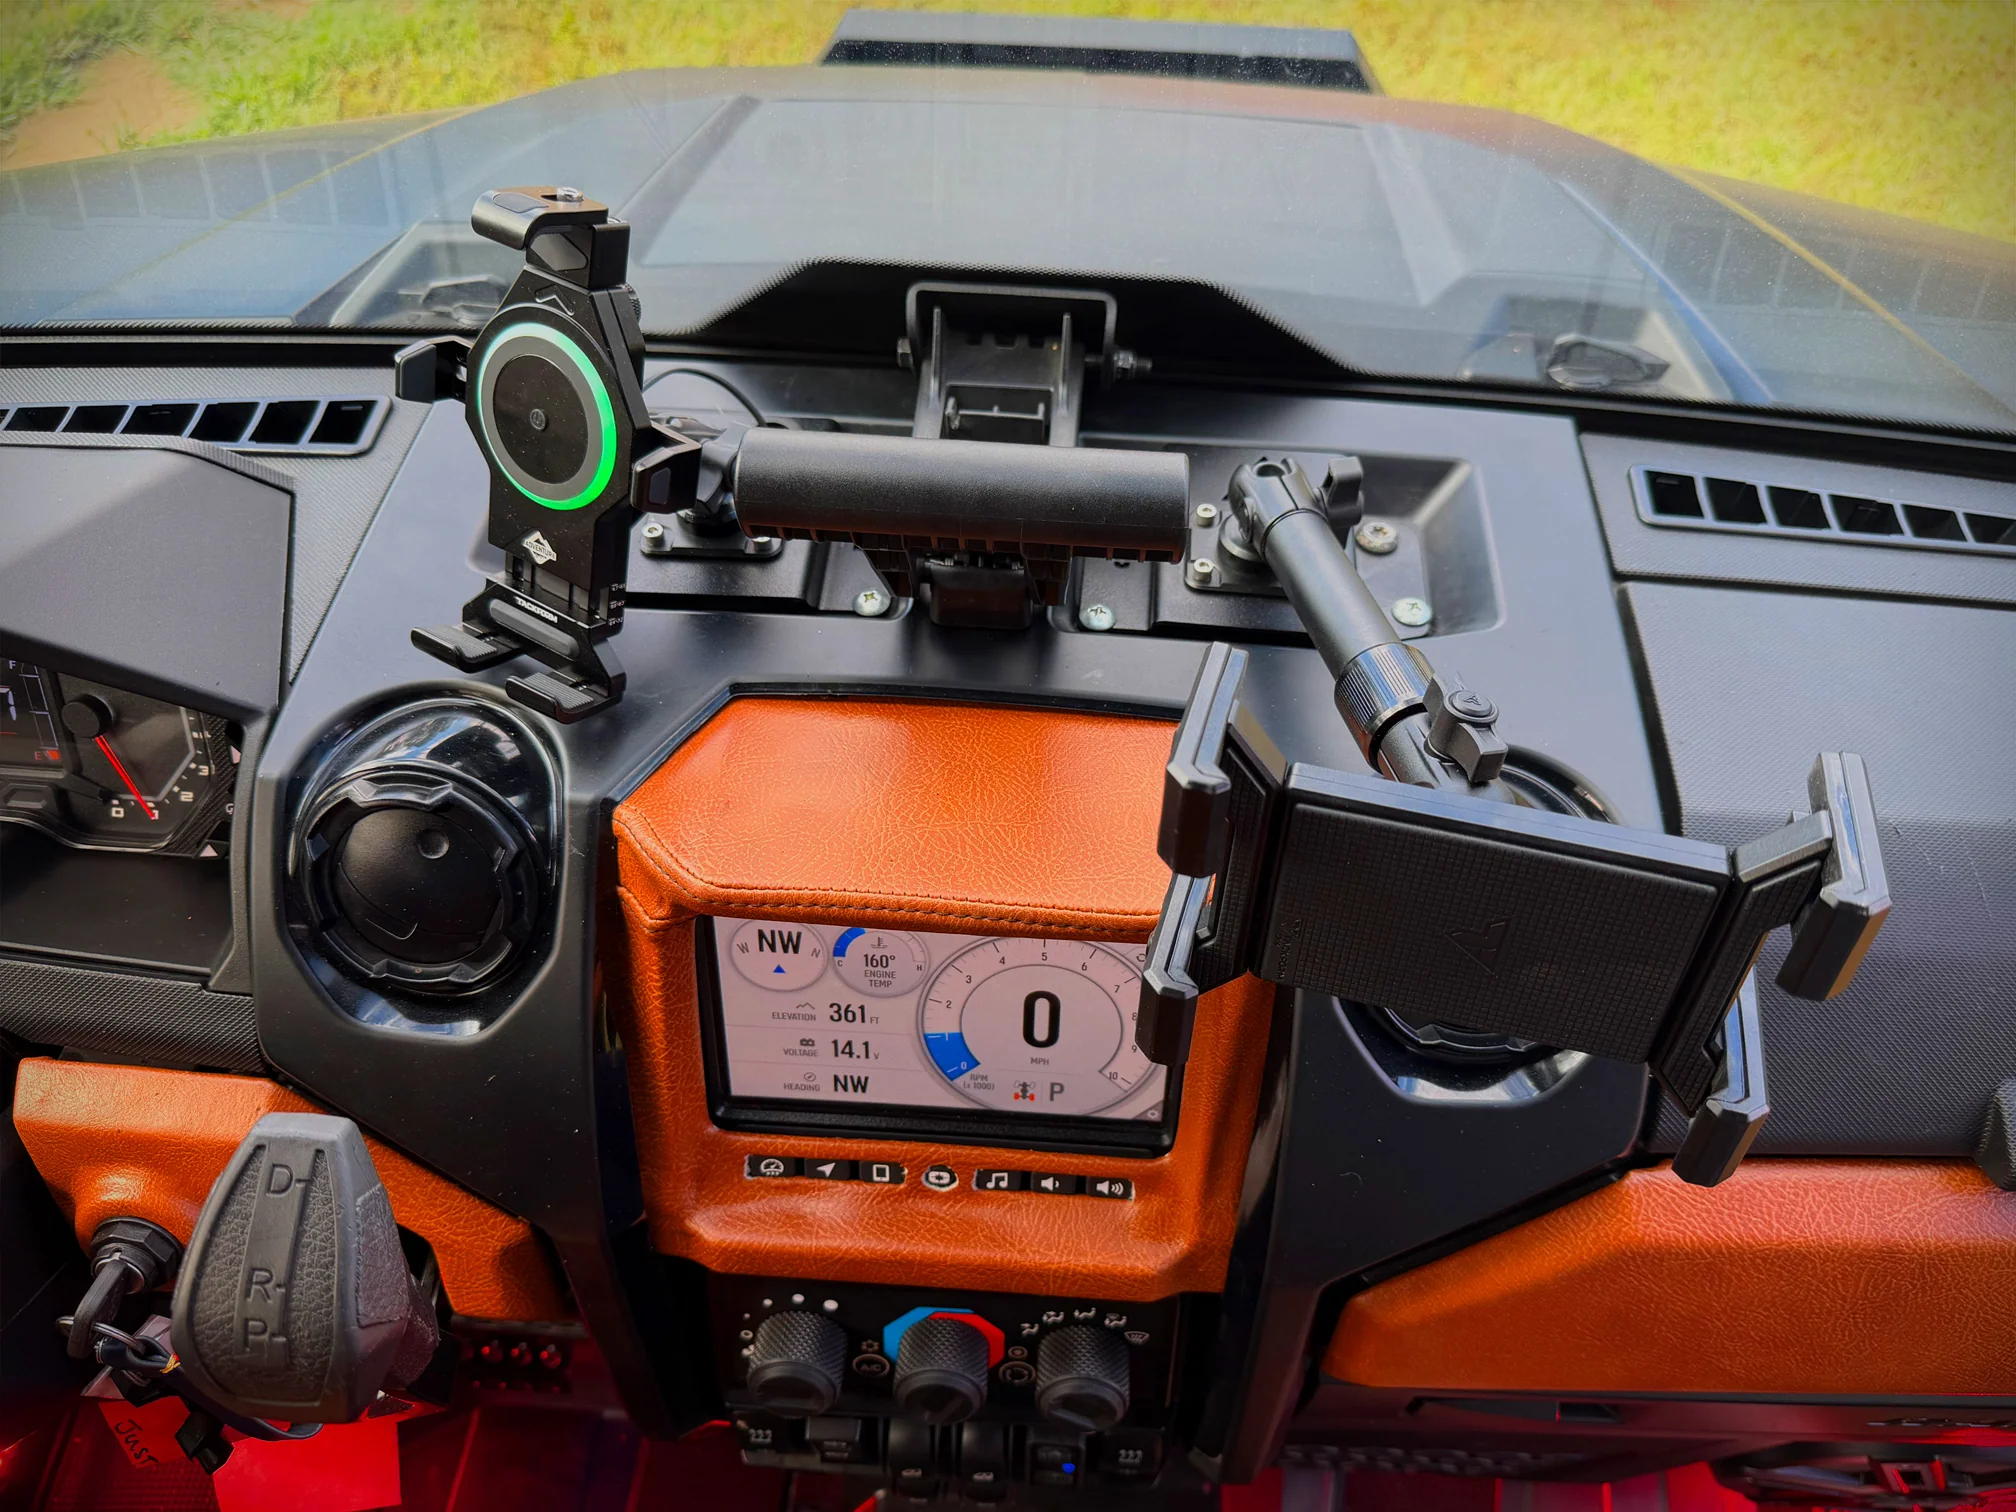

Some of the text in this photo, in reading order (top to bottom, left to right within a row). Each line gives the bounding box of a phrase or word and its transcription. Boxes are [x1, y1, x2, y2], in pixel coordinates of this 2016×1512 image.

[524, 540, 556, 560] ADVENTURE
[514, 596, 558, 623] TACKFORM
[9, 660, 16, 670] F
[34, 751, 42, 760] E
[198, 765, 209, 776] 3
[180, 791, 194, 802] 2
[757, 928, 802, 955] NW
[736, 942, 750, 954] W
[811, 947, 821, 958] N
[999, 956, 1006, 965] 4
[1041, 953, 1048, 961] 5
[837, 959, 843, 967] C
[916, 964, 923, 972] H
[1081, 962, 1088, 972] 6
[864, 969, 896, 979] ENGINE
[868, 979, 893, 988] TEMP
[966, 975, 972, 984] 3
[1114, 984, 1121, 994] 7
[946, 1000, 952, 1009] 2
[772, 1011, 817, 1022] ELEVATION
[829, 1002, 880, 1024] 361 FT
[1131, 1012, 1138, 1021] 8
[1023, 990, 1061, 1048] 0
[783, 1048, 818, 1057] VOLTAGE
[831, 1039, 870, 1060] 14.1
[1131, 1044, 1138, 1053] 9
[960, 1061, 967, 1070] 0
[1030, 1057, 1050, 1066] MPH
[970, 1073, 988, 1082] RPM
[1108, 1071, 1118, 1081] 10
[783, 1082, 821, 1092] HEADING
[833, 1074, 869, 1094] NW
[1049, 1082, 1065, 1101] P
[266, 1163, 293, 1197] D
[248, 1268, 274, 1301] R
[243, 1318, 268, 1350] P
